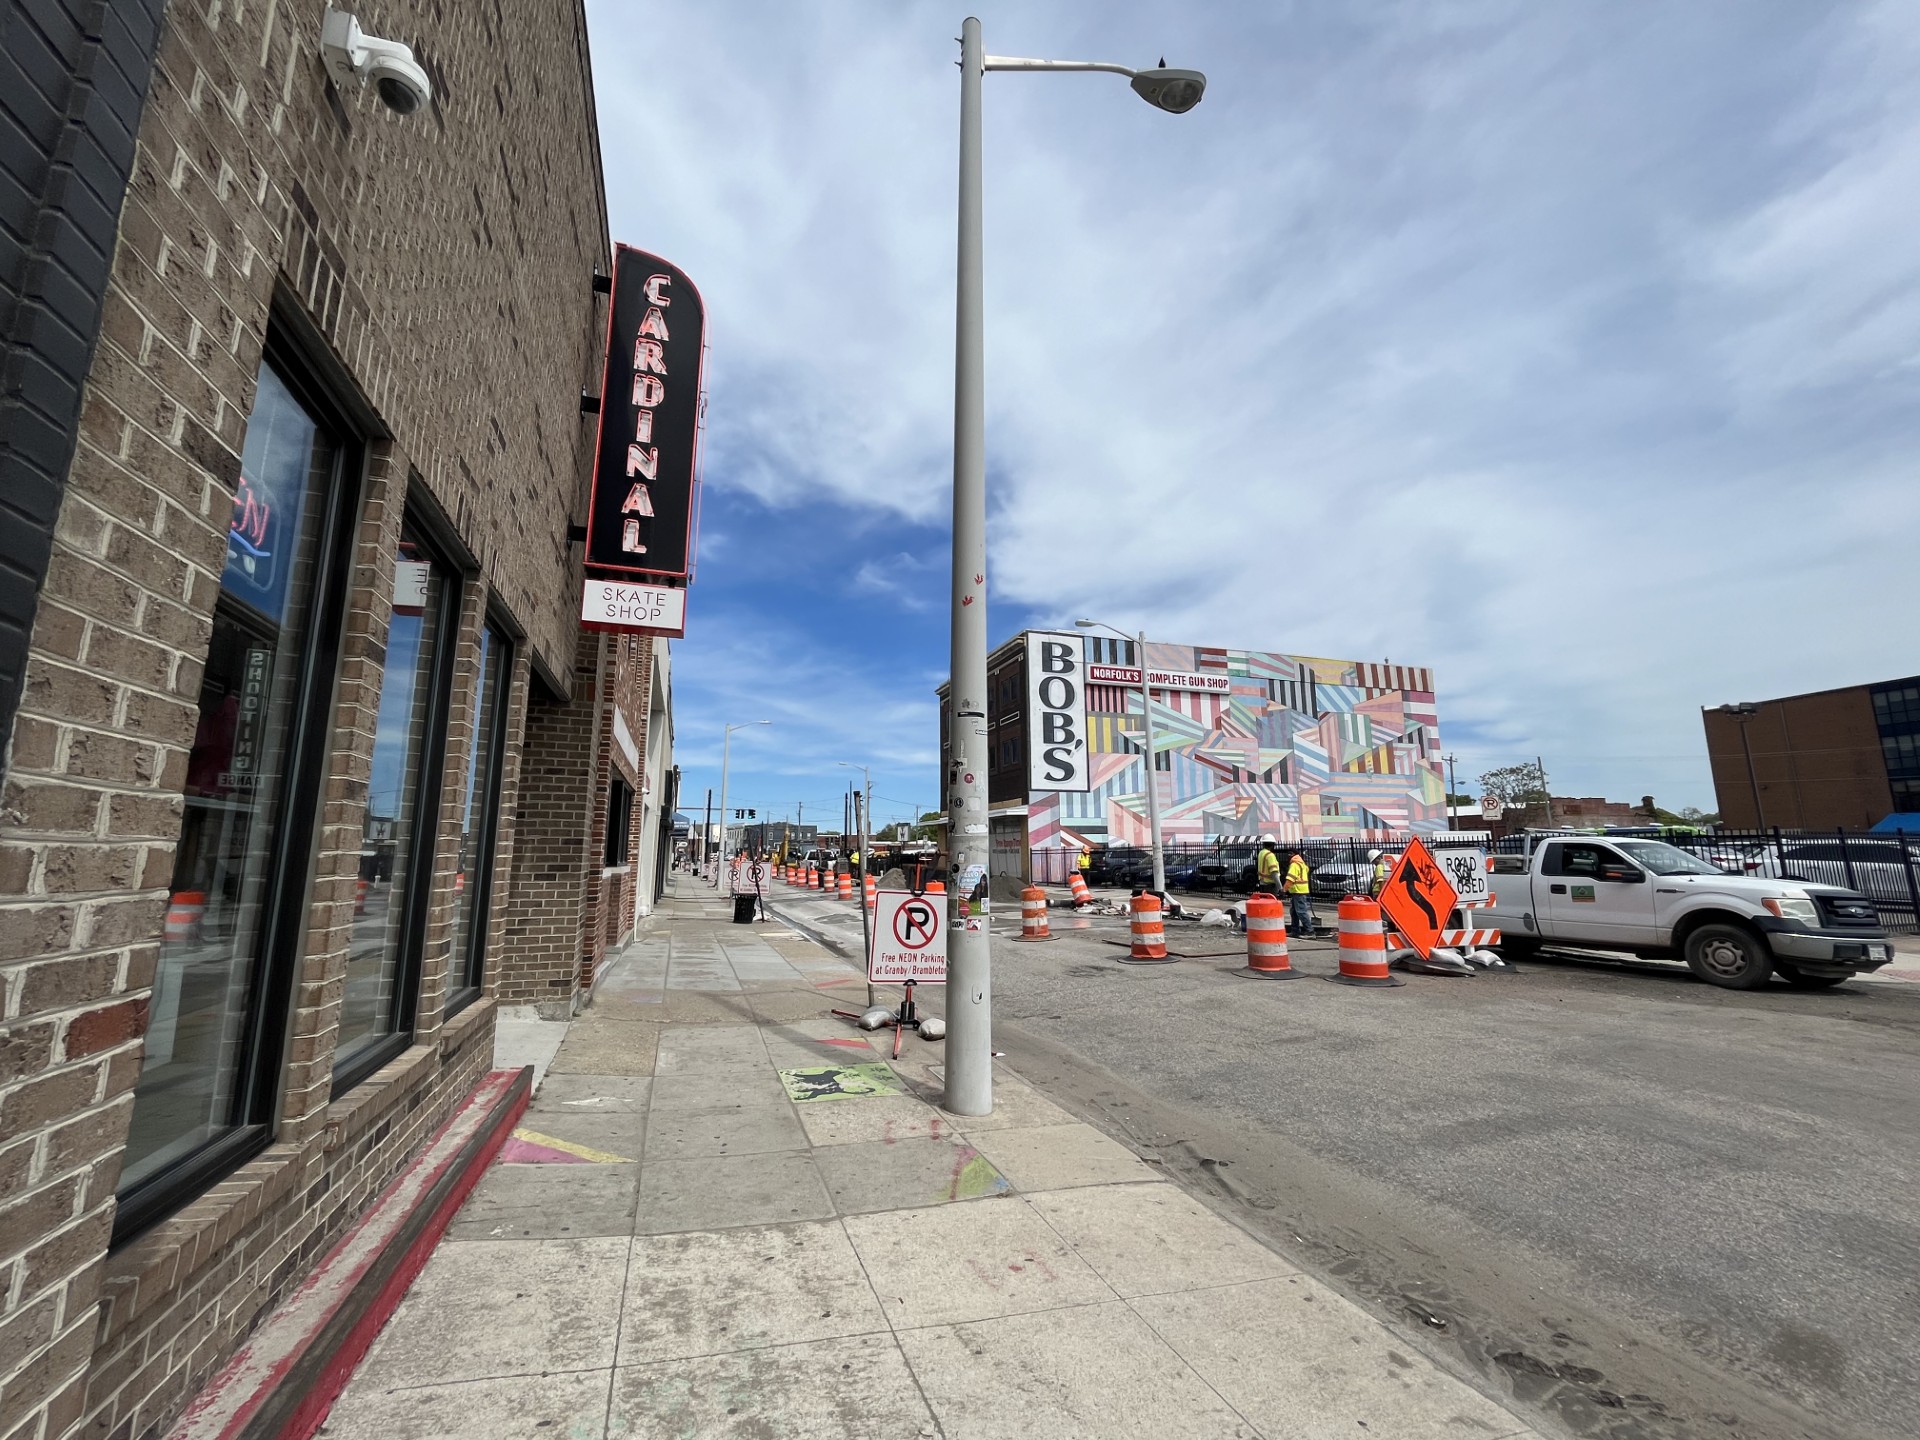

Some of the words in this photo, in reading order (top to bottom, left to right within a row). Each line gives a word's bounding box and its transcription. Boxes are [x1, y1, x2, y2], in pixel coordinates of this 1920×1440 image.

[622, 273, 673, 555] CARDINAL
[602, 586, 667, 606] SKATE
[604, 604, 662, 622] SHOP
[1093, 667, 1140, 682] NORFOLK'S
[1189, 676, 1205, 687] GUN
[1207, 678, 1229, 689] SHOP
[1038, 641, 1085, 783] BOB'S
[1445, 856, 1477, 873] ROAD
[881, 952, 896, 963] Free
[898, 952, 918, 963] NEON
[920, 953, 945, 965] Parking
[875, 966, 883, 975] at
